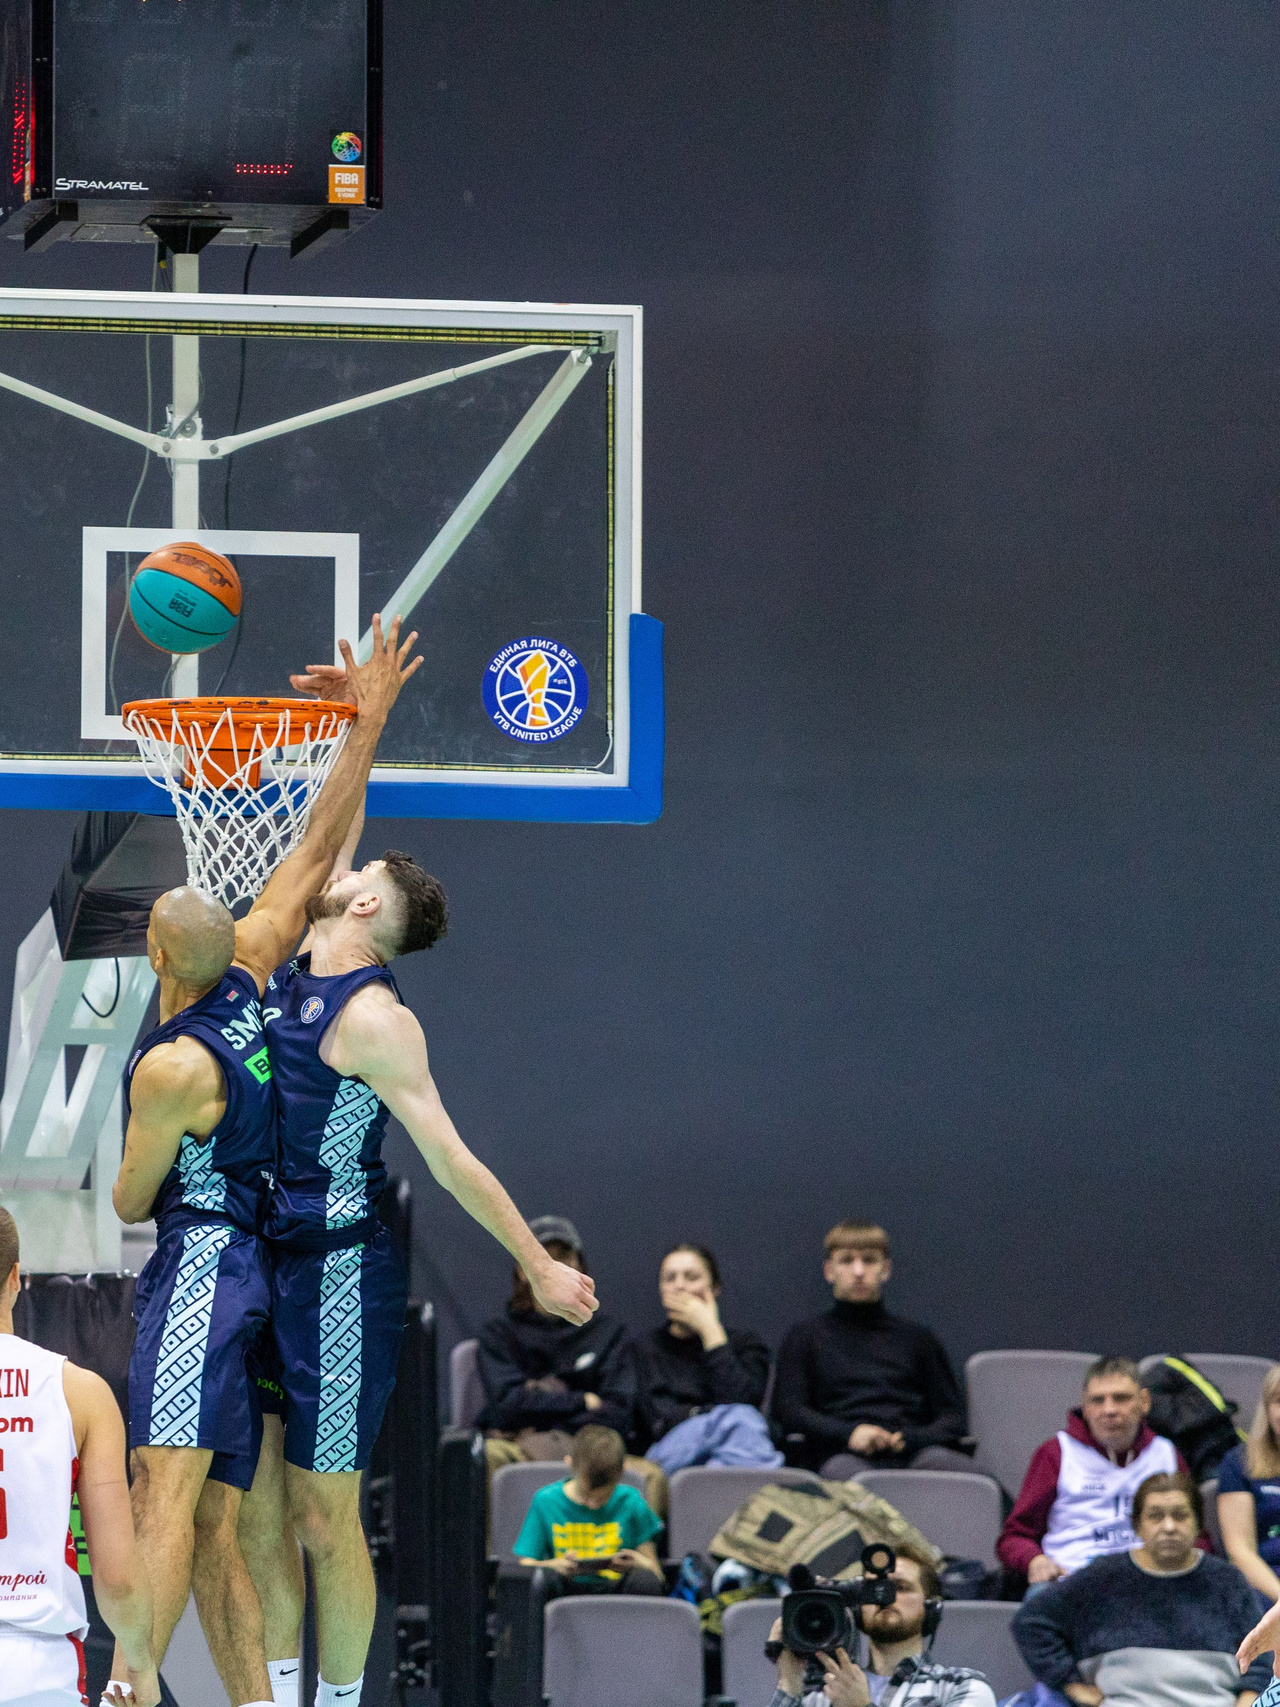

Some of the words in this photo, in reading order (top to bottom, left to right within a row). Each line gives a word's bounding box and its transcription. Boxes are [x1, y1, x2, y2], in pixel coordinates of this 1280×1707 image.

[54, 178, 149, 191] STRAMATEL
[334, 172, 359, 184] FIBA
[168, 598, 194, 617] FIBA
[489, 640, 528, 673] ЕДИНАЯ
[529, 639, 558, 653] ЛИГА
[558, 648, 578, 668] ВТБ
[493, 711, 511, 730] VTB
[509, 727, 549, 741] UNITED
[549, 706, 583, 738] LEAGUE
